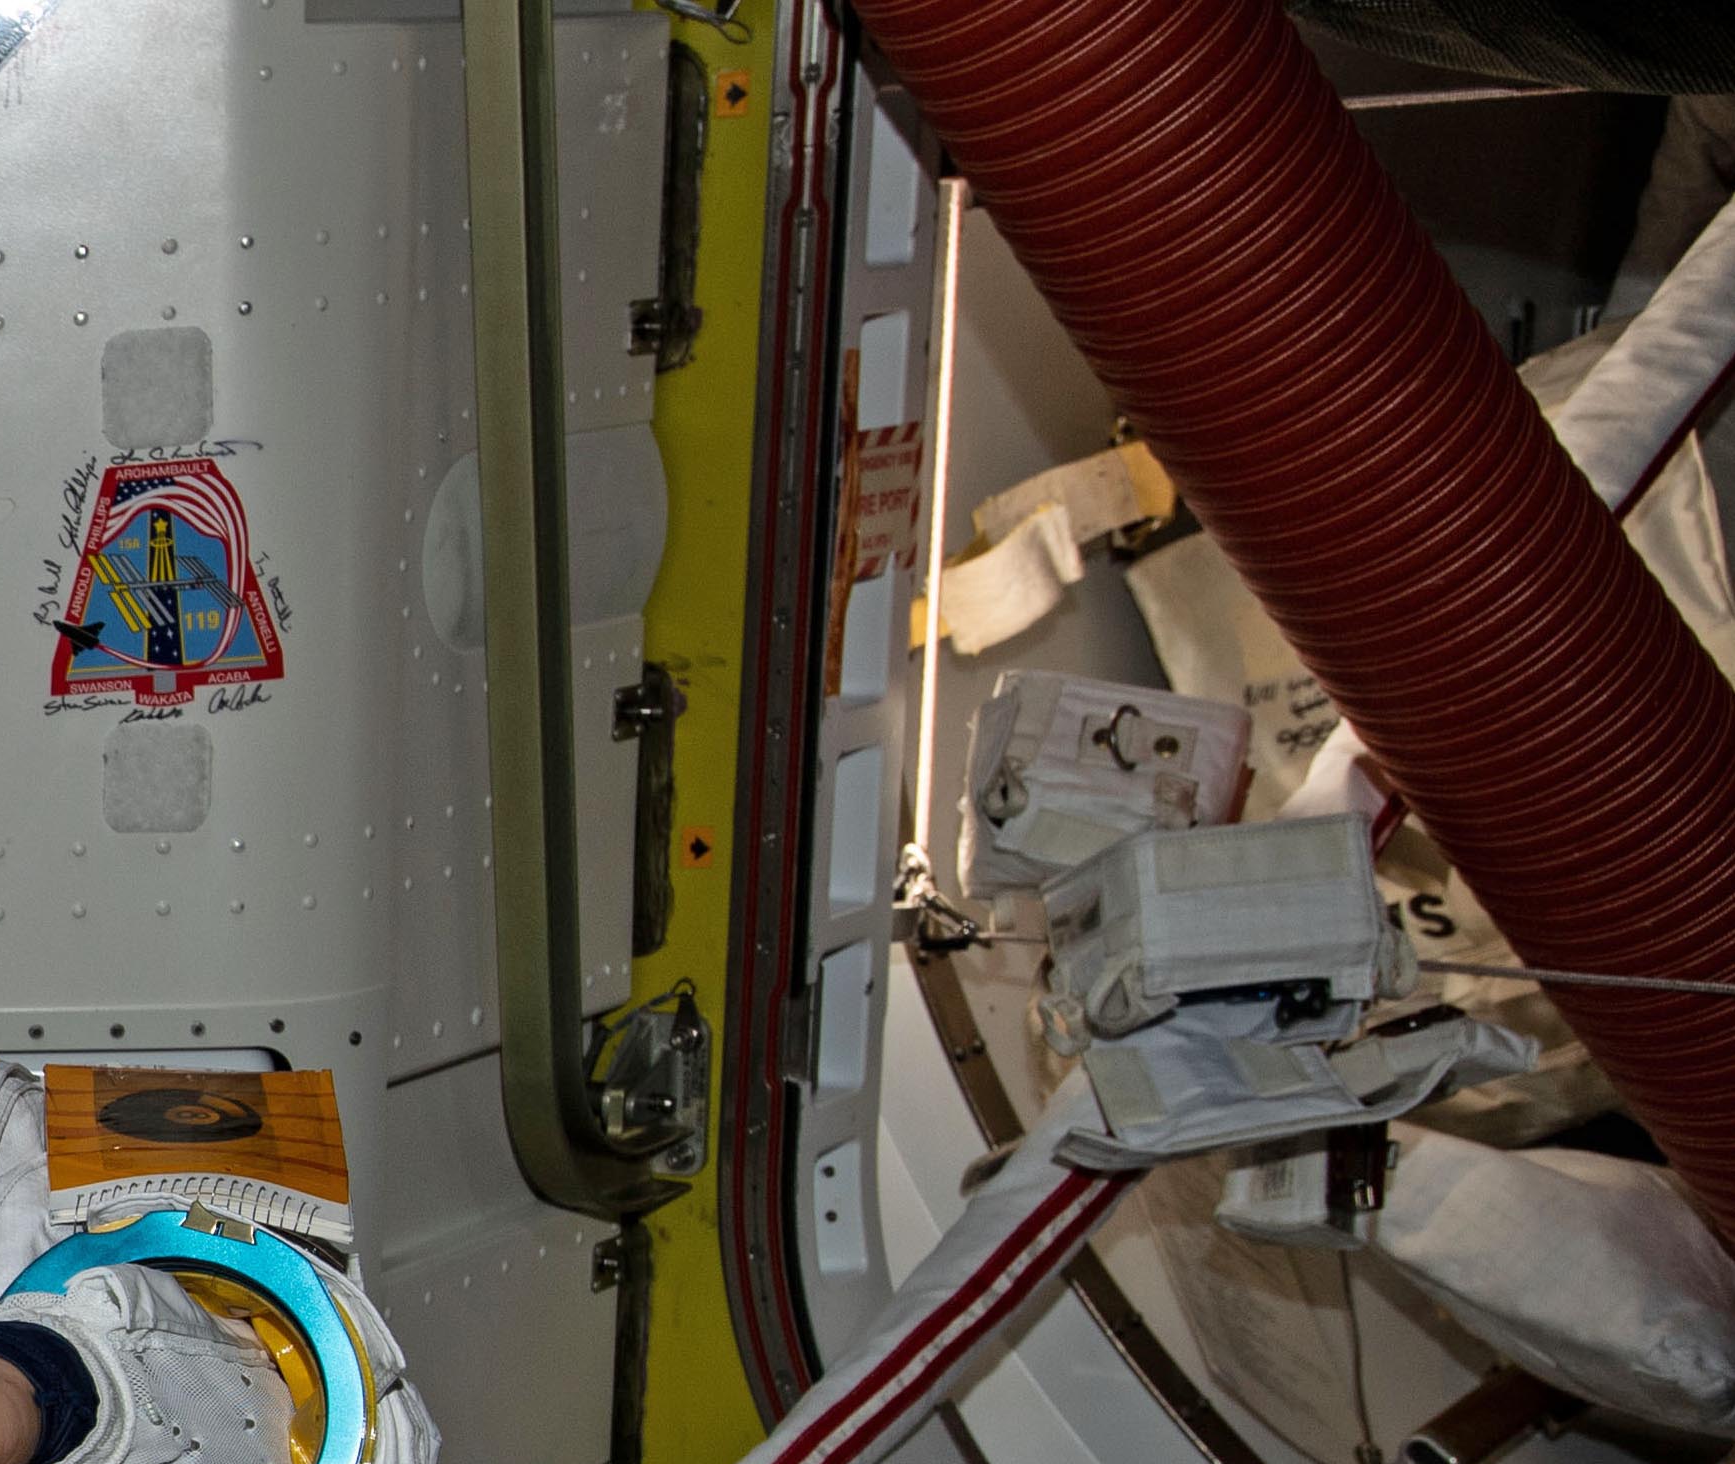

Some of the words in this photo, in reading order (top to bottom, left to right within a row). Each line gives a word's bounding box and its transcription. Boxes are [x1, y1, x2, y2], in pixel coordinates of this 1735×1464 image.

[115, 462, 211, 480] ARCHAMBAULT
[88, 496, 111, 550] PHILLIPS
[71, 566, 92, 618] ARNOLD
[185, 611, 220, 631] 119
[246, 590, 277, 653] ANTONELLI
[208, 670, 251, 684] ACABA
[69, 679, 133, 695] SWANSON
[139, 691, 193, 705] WAKATA
